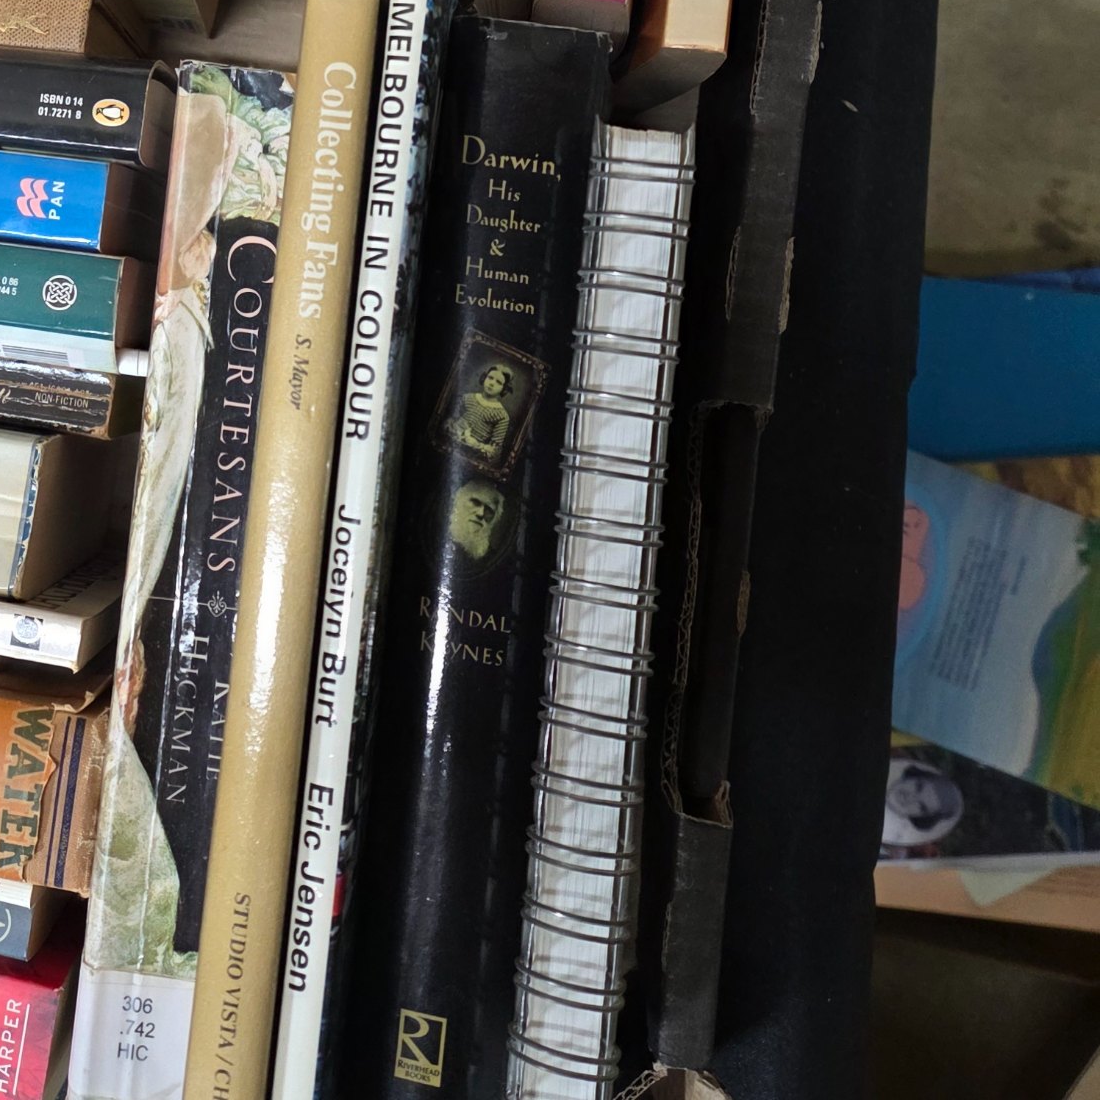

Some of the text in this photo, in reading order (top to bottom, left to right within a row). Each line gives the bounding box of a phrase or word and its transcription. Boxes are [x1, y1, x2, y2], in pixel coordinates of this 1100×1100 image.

[38, 107, 72, 117] 01.7271
[462, 135, 562, 181] Darwin,
[48, 180, 65, 220] PAN
[299, 61, 358, 320] Collecting Fans
[488, 179, 521, 202] His
[346, 2, 415, 441] MELBOURNE IN COLOUR
[466, 204, 541, 233] Daughter
[465, 256, 530, 285] Human
[455, 284, 535, 315] Evolution
[207, 235, 277, 573] COURTESANS
[315, 505, 361, 727] Jocelyn Burt
[288, 783, 334, 993] Eric Jensen
[122, 996, 153, 1014] 306
[120, 1021, 155, 1039] .742
[117, 1043, 149, 1061] HIC
[397, 1059, 440, 1077] RIVERHEAD
[404, 1069, 431, 1082] BOOKS
